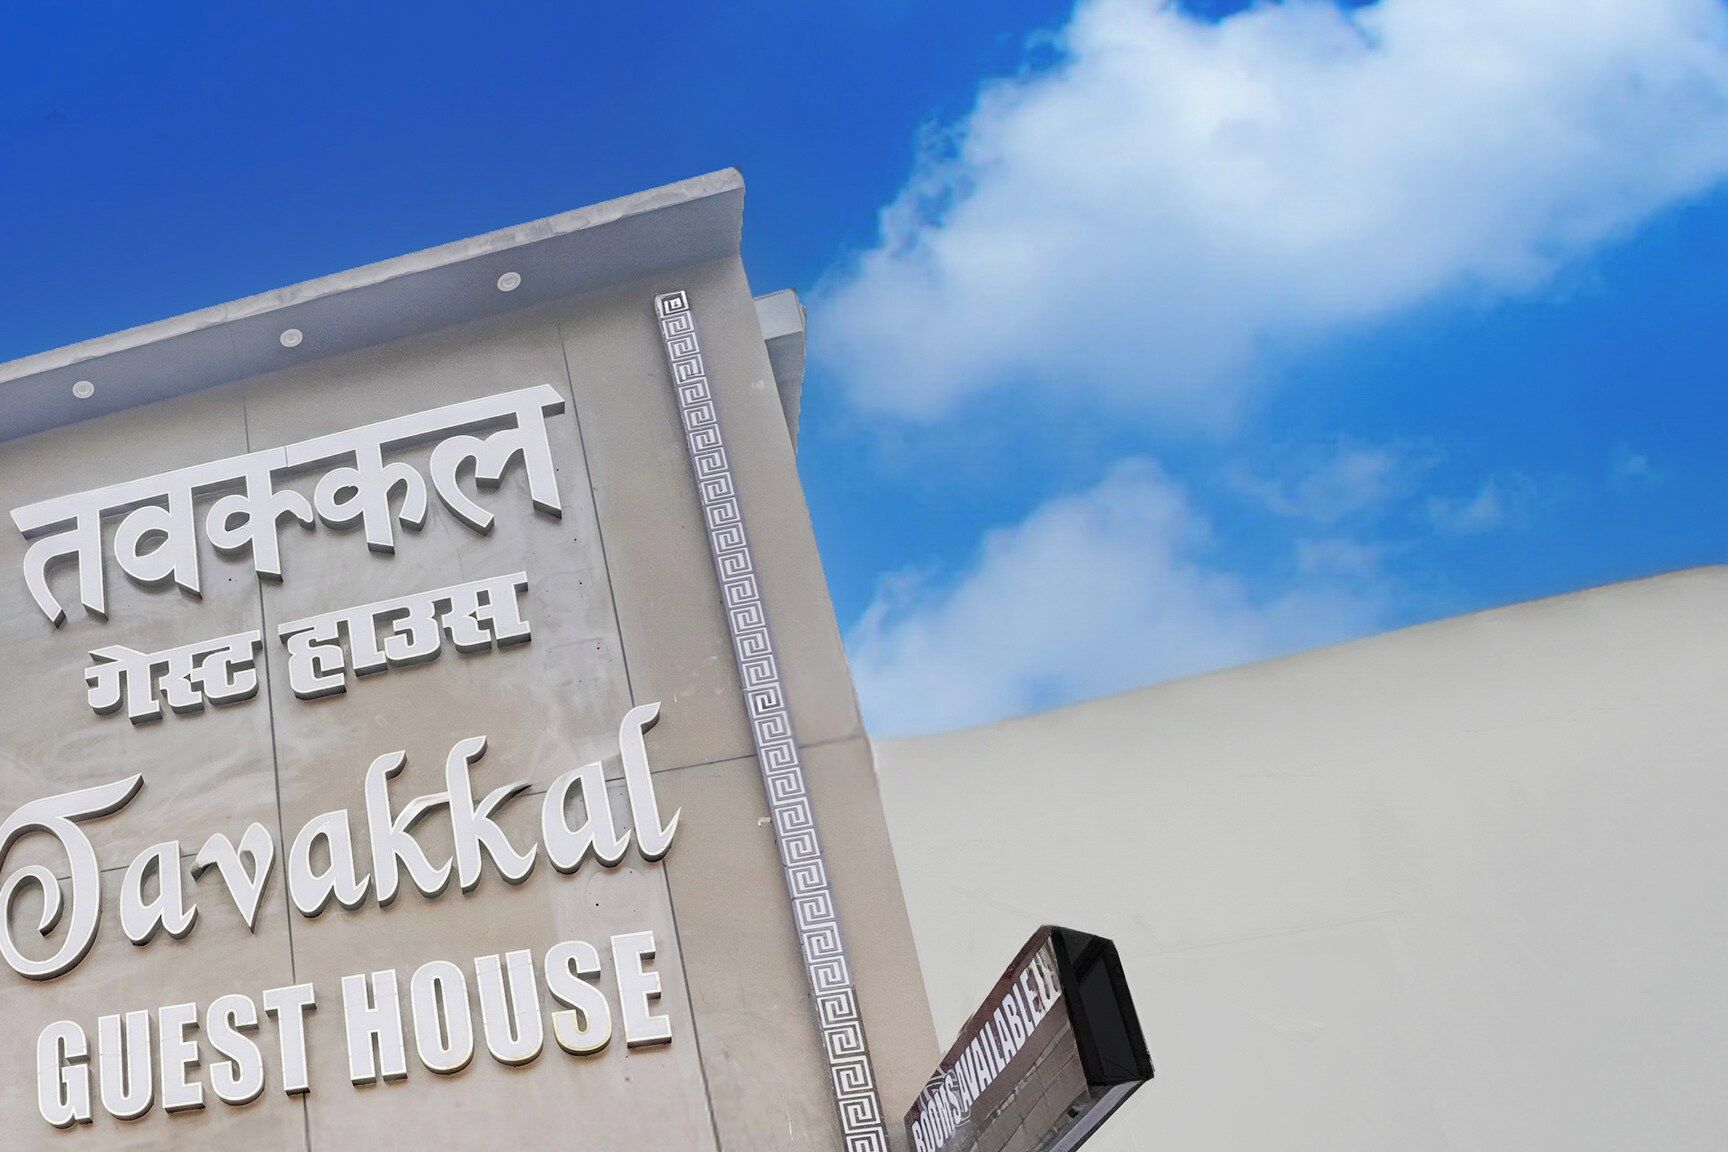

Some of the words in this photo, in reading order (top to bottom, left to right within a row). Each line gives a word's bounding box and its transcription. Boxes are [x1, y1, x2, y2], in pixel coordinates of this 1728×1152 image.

[11, 384, 565, 627] तवक्कल
[84, 629, 263, 725] गेस्ट
[278, 572, 532, 700] हाउस
[36, 982, 317, 1130] GUEST
[341, 930, 674, 1085] HOUSE
